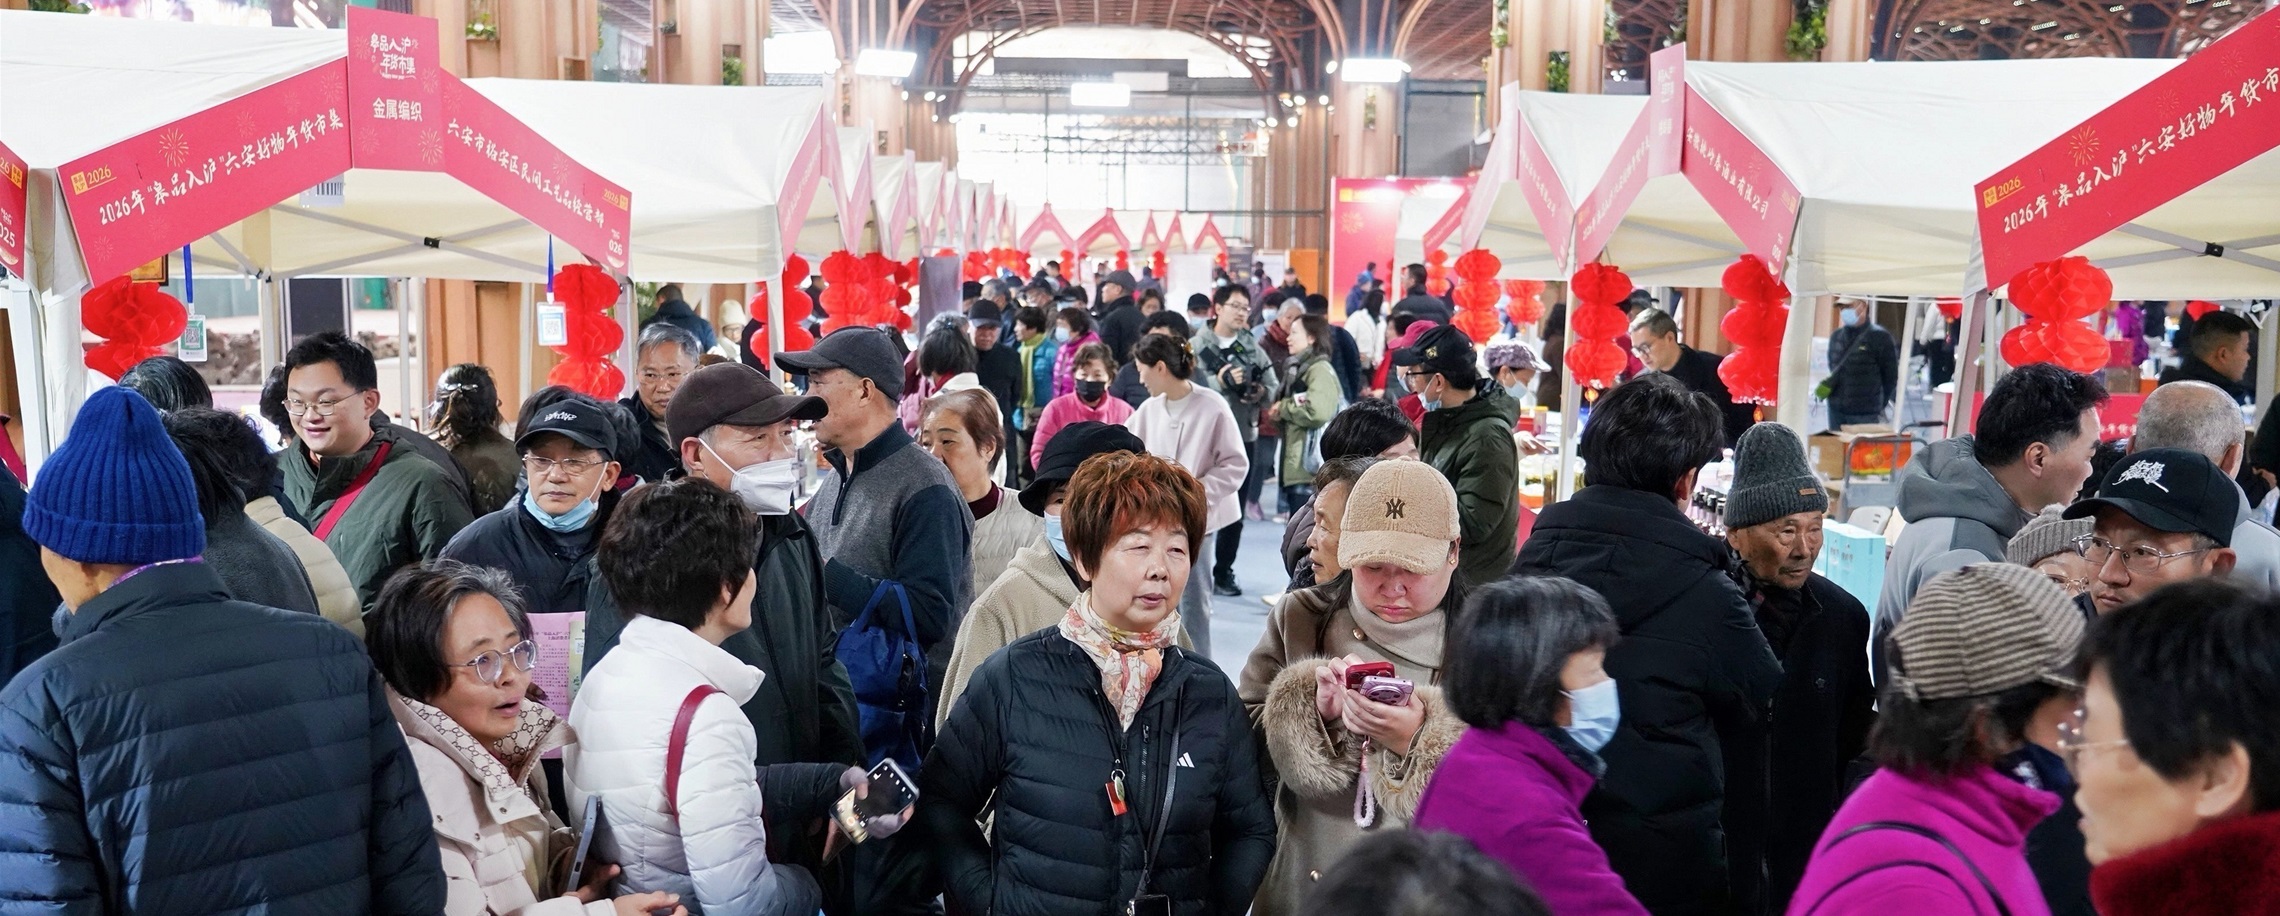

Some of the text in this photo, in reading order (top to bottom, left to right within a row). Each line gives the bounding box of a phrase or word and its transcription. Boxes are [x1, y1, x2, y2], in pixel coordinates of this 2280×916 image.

[373, 97, 423, 122] 金属编织
[87, 164, 112, 185] 2026
[1998, 175, 2021, 197] 2026
[609, 239, 623, 256] 026
[1385, 498, 1406, 520] NY
